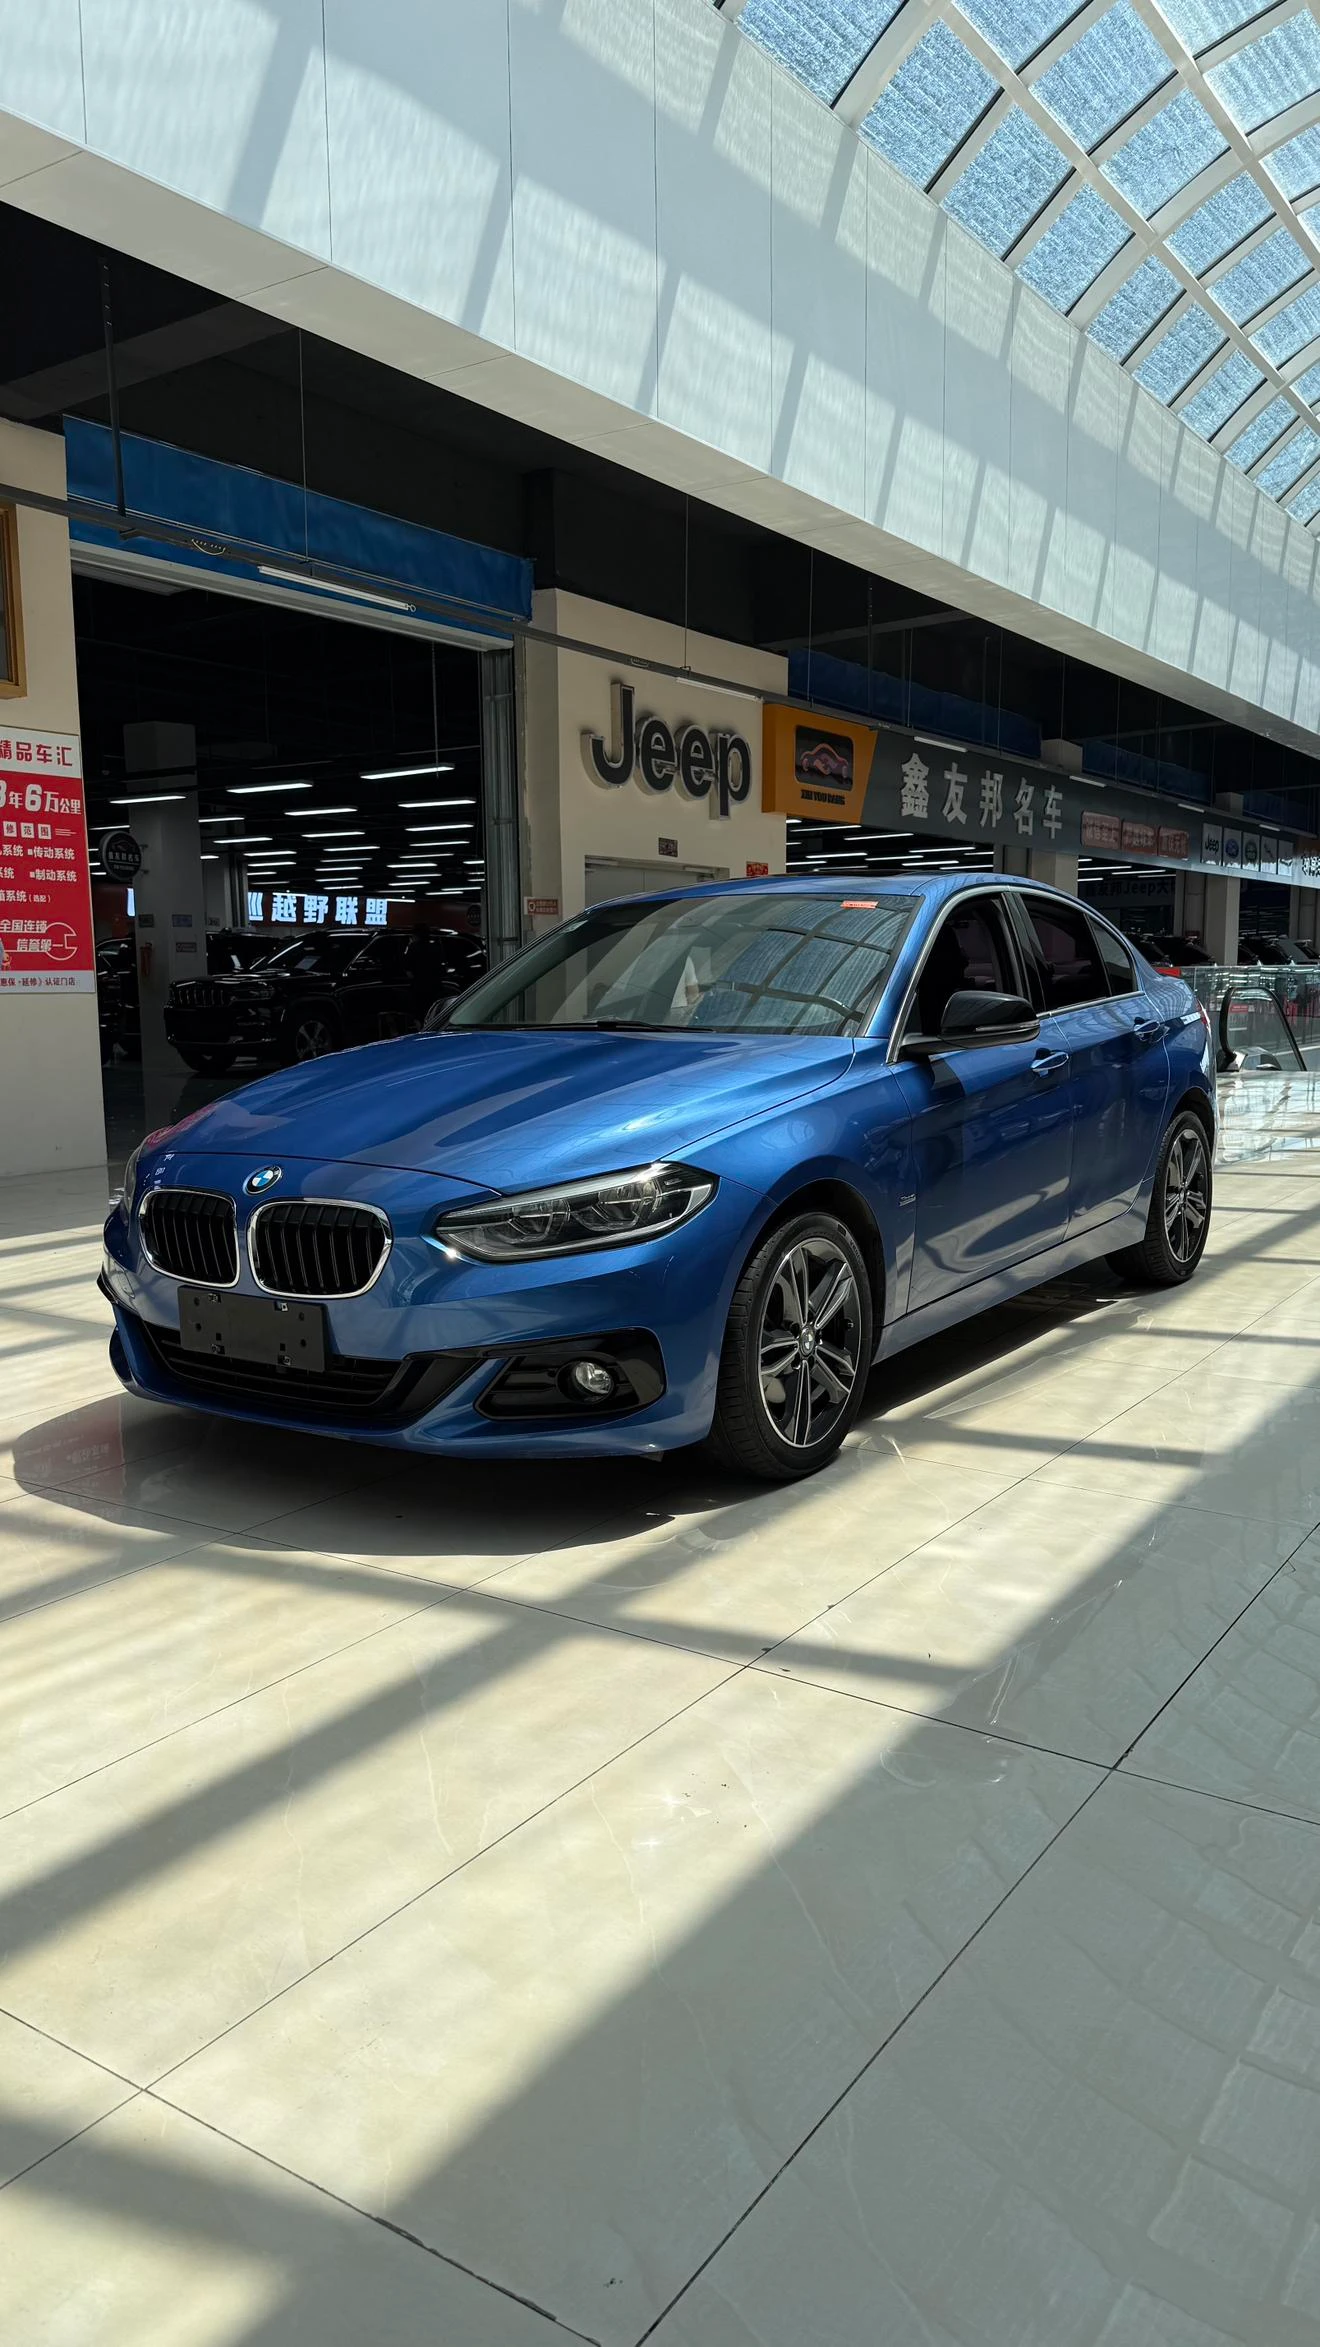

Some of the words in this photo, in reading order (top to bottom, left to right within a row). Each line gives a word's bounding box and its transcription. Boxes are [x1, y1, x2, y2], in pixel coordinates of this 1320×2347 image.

[580, 681, 752, 821] Jeep
[900, 752, 1063, 839] 鑫友邦名车
[0, 844, 23, 857] 系统
[34, 846, 75, 860] 传动系统
[1204, 834, 1220, 855] Jeep
[35, 868, 77, 882] 制动系统
